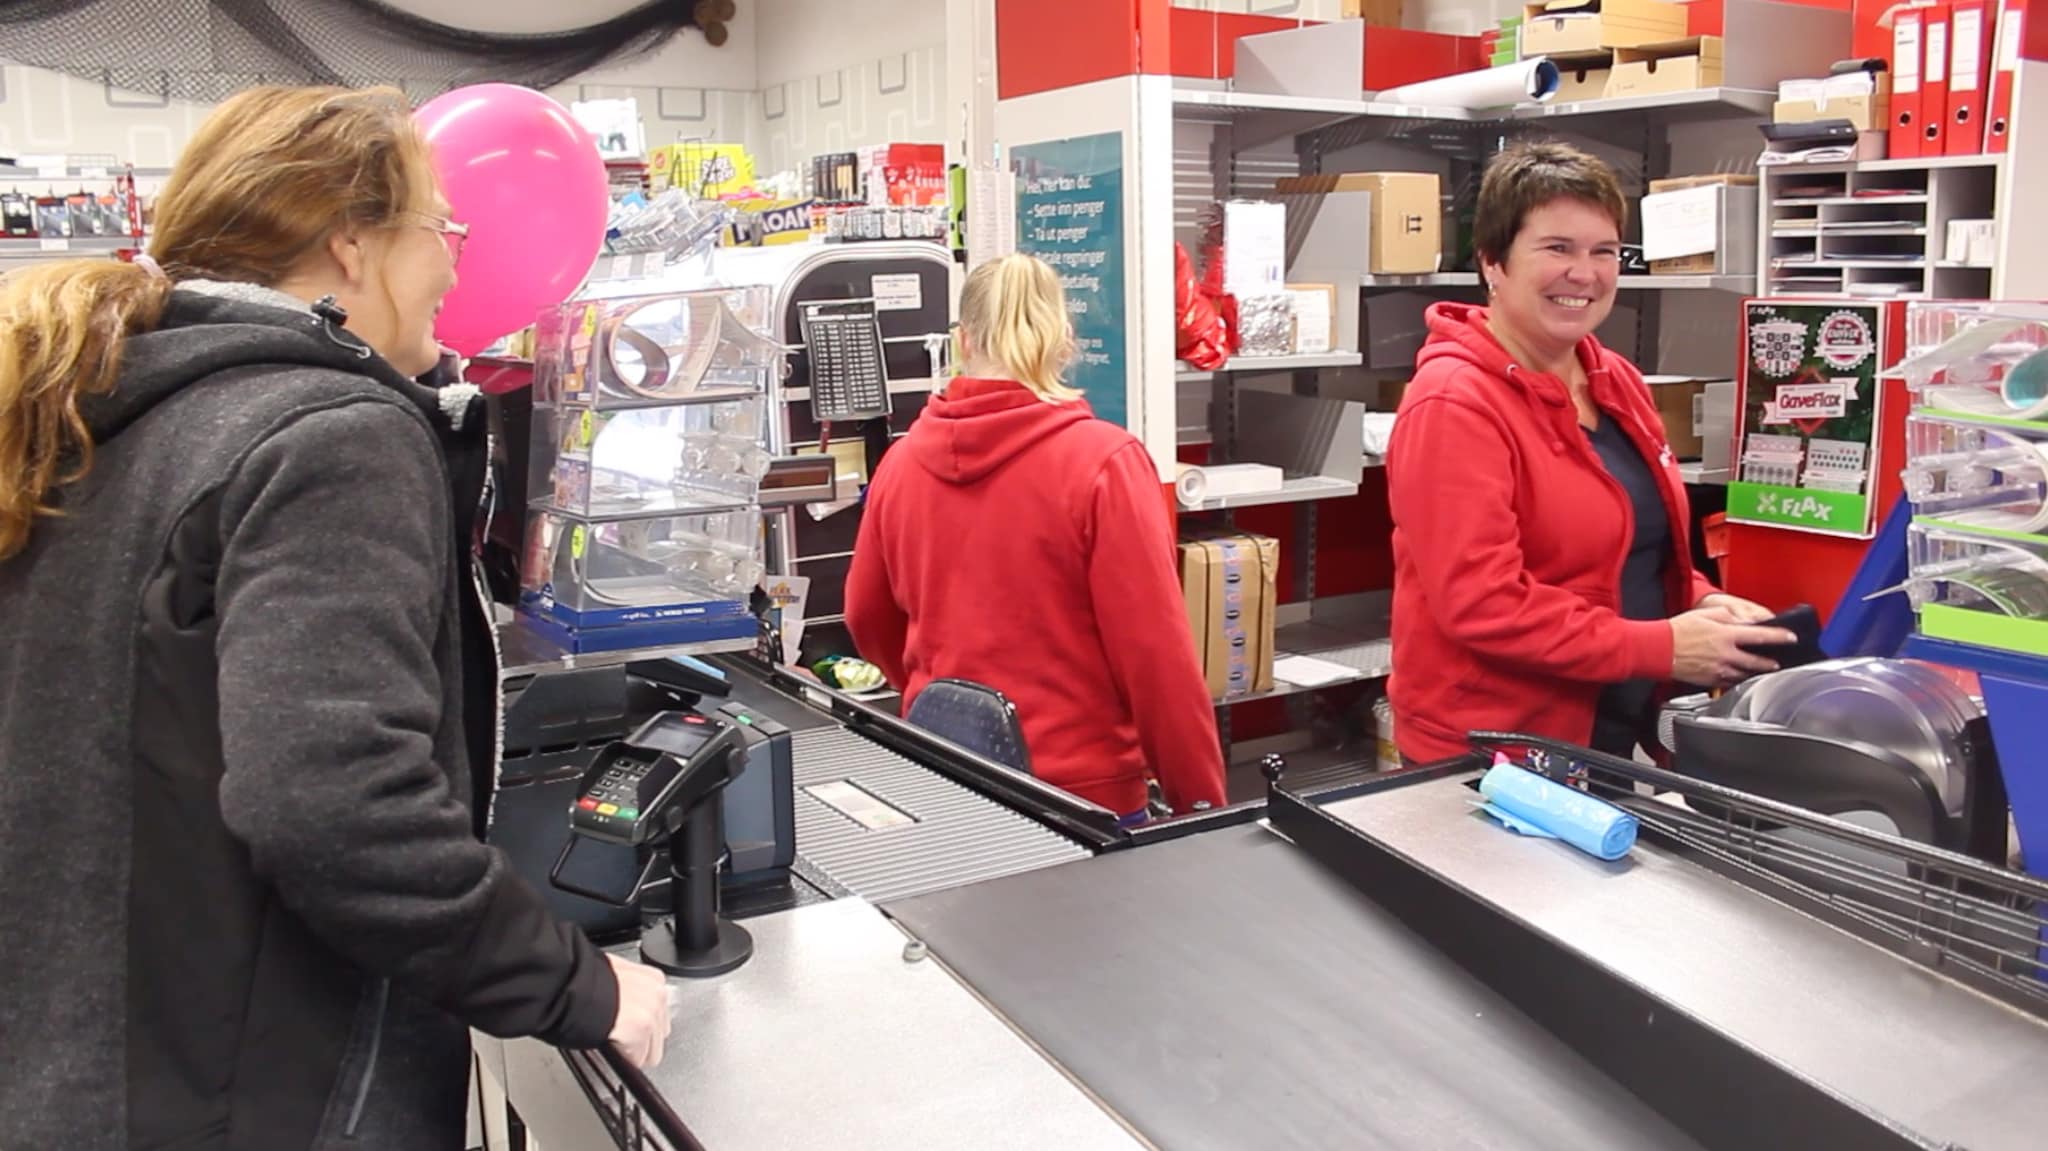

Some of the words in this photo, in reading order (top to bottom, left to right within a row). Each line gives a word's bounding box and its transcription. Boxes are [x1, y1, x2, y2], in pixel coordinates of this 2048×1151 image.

[1034, 203, 1056, 218] Sette
[1058, 201, 1072, 216] inn
[1073, 201, 1104, 219] penger
[1035, 227, 1045, 241] Ta
[1046, 228, 1056, 241] ut
[1057, 227, 1088, 244] penger
[1062, 249, 1105, 268] regninger
[1780, 391, 1841, 409] GaveFlax
[1781, 496, 1833, 521] FLAX
